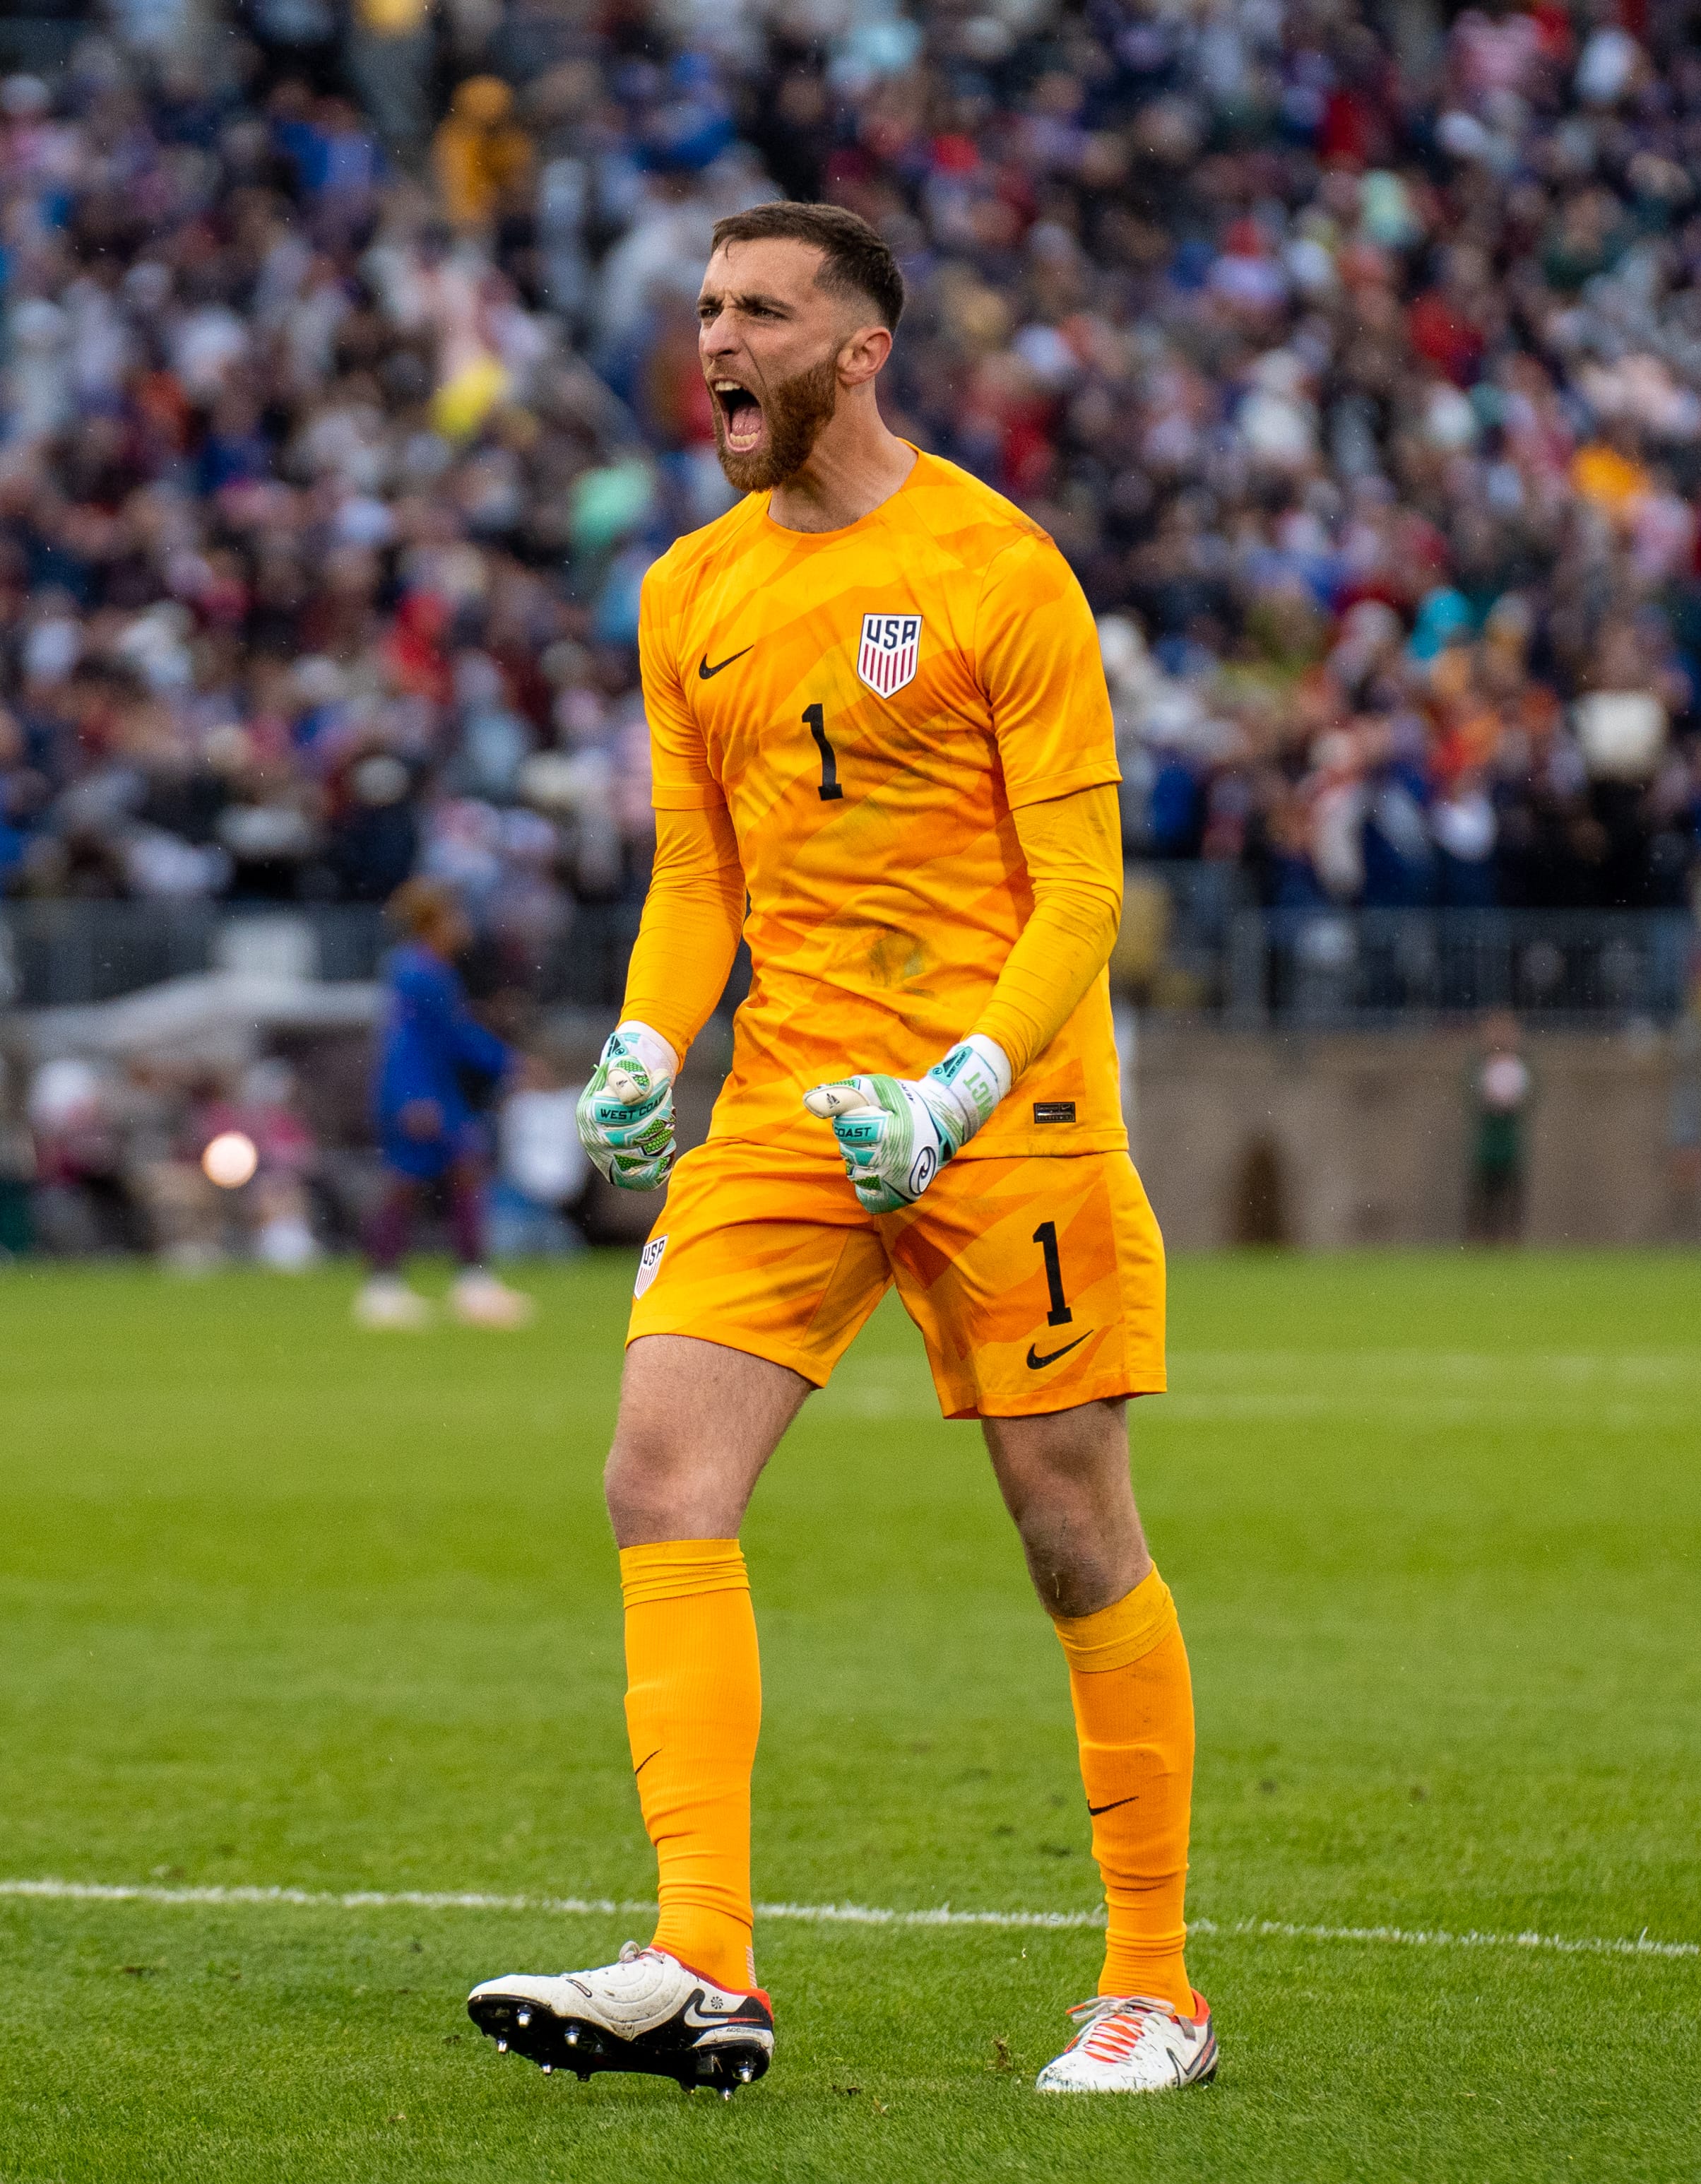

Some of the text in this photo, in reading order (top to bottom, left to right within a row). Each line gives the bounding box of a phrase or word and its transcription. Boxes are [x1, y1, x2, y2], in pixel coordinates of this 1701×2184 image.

[866, 619, 918, 650] USA
[802, 703, 843, 801] 1
[600, 1091, 667, 1120] WEST COA
[643, 1239, 665, 1267] USA
[1032, 1221, 1073, 1327] 1
